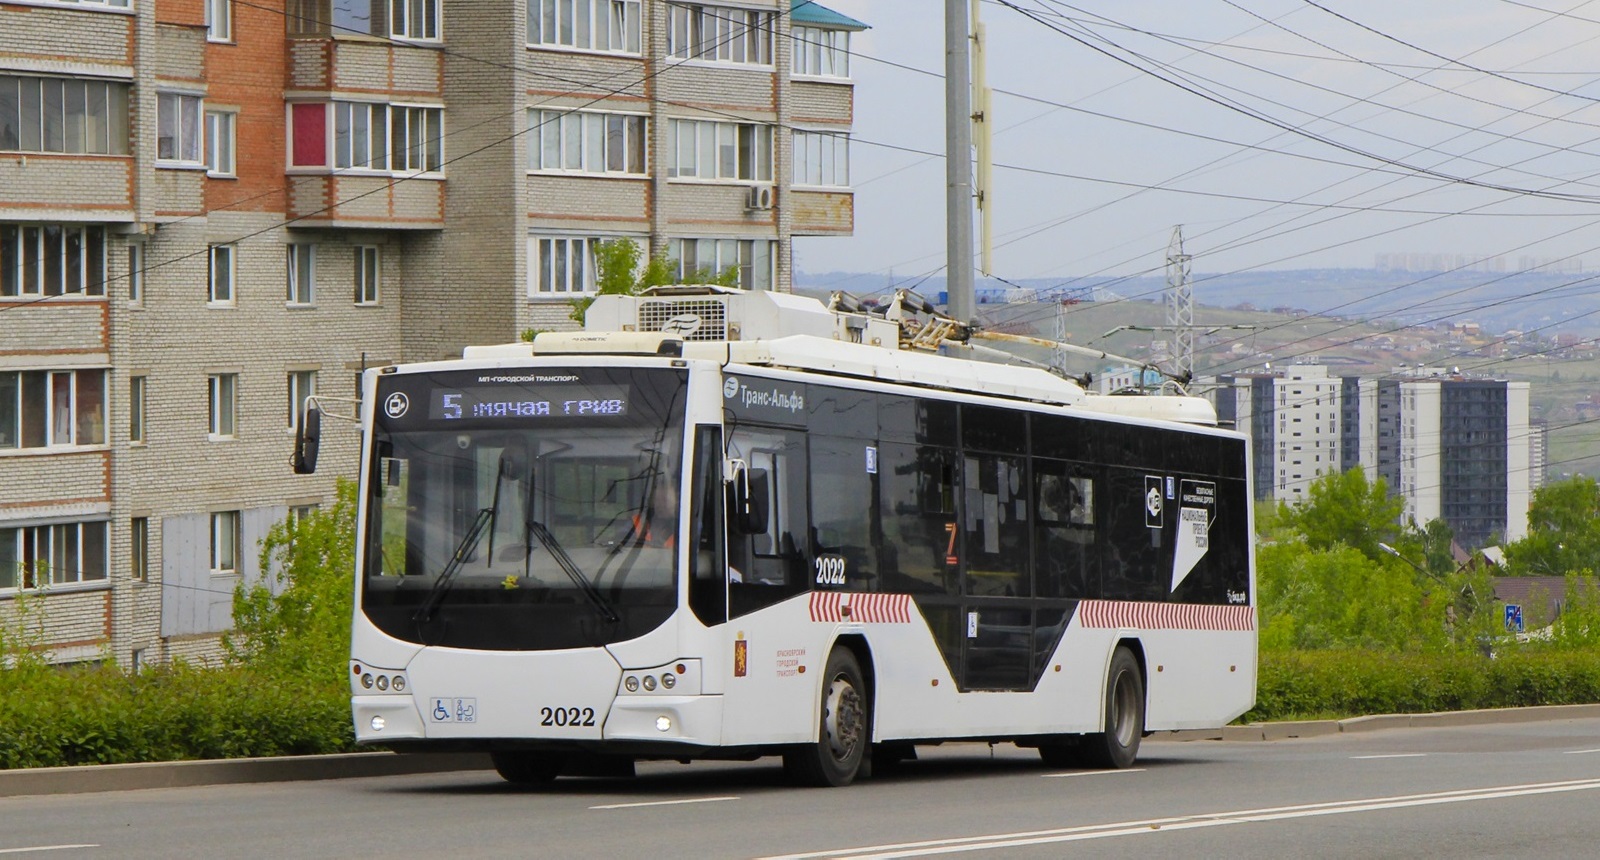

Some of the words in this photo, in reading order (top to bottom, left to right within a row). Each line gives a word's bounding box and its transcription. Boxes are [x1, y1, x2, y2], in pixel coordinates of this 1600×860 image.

[490, 374, 535, 383] «ГОРОДСКОЙ
[442, 393, 463, 419] 5
[740, 384, 804, 413] Транс-Альфа
[815, 557, 846, 585] 2022
[540, 707, 596, 728] 2022
